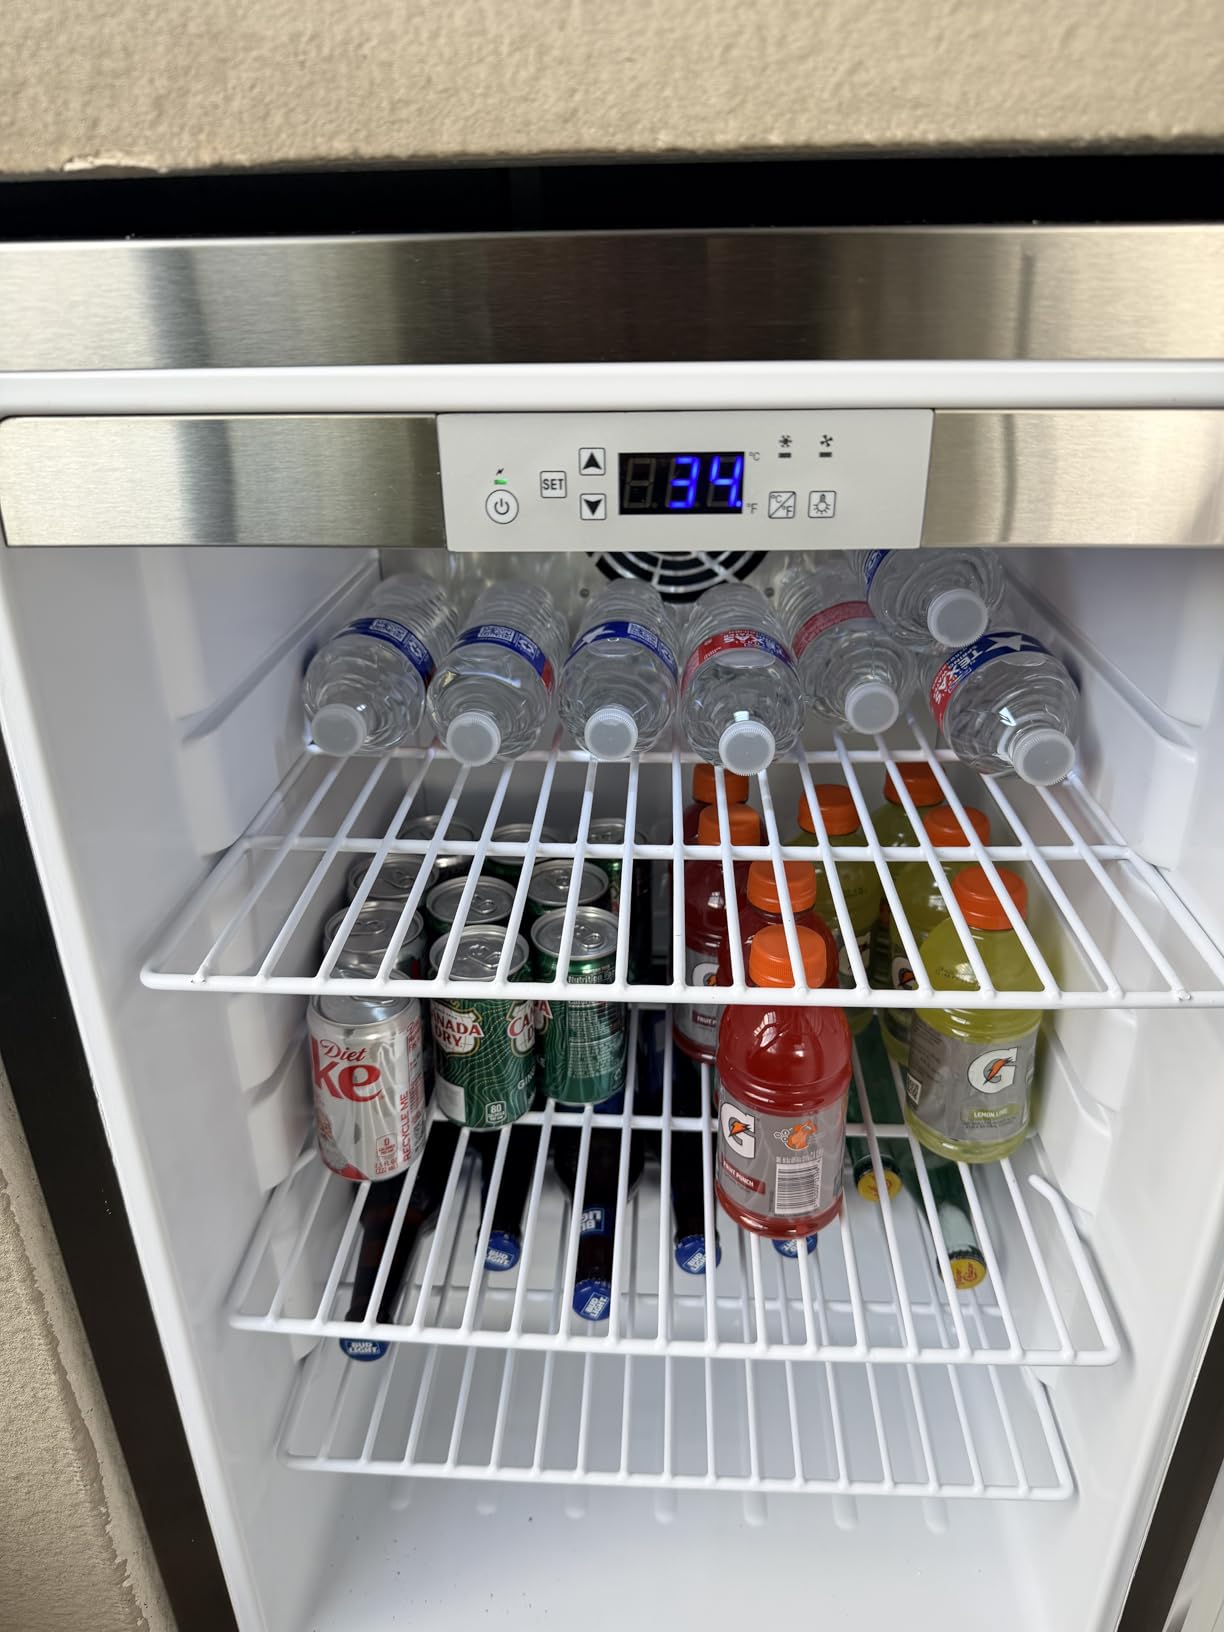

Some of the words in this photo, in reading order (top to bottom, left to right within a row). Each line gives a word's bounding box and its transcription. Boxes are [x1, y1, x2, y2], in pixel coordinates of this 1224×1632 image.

[543, 479, 564, 490] SET
[934, 649, 983, 704] TEXAS
[435, 1025, 462, 1047] DRY
[320, 1039, 368, 1062] Diet
[967, 1047, 1018, 1094] G
[400, 1090, 409, 1111] ME
[490, 1104, 502, 1114] 80
[400, 1112, 412, 1162] RECYCLE
[720, 1102, 755, 1159] G
[723, 1161, 736, 1177] FRUIT
[736, 1171, 755, 1188] PUNCH
[687, 1252, 703, 1267] BUD
[585, 1297, 599, 1313] BUD
[590, 1296, 609, 1317] LIGHT
